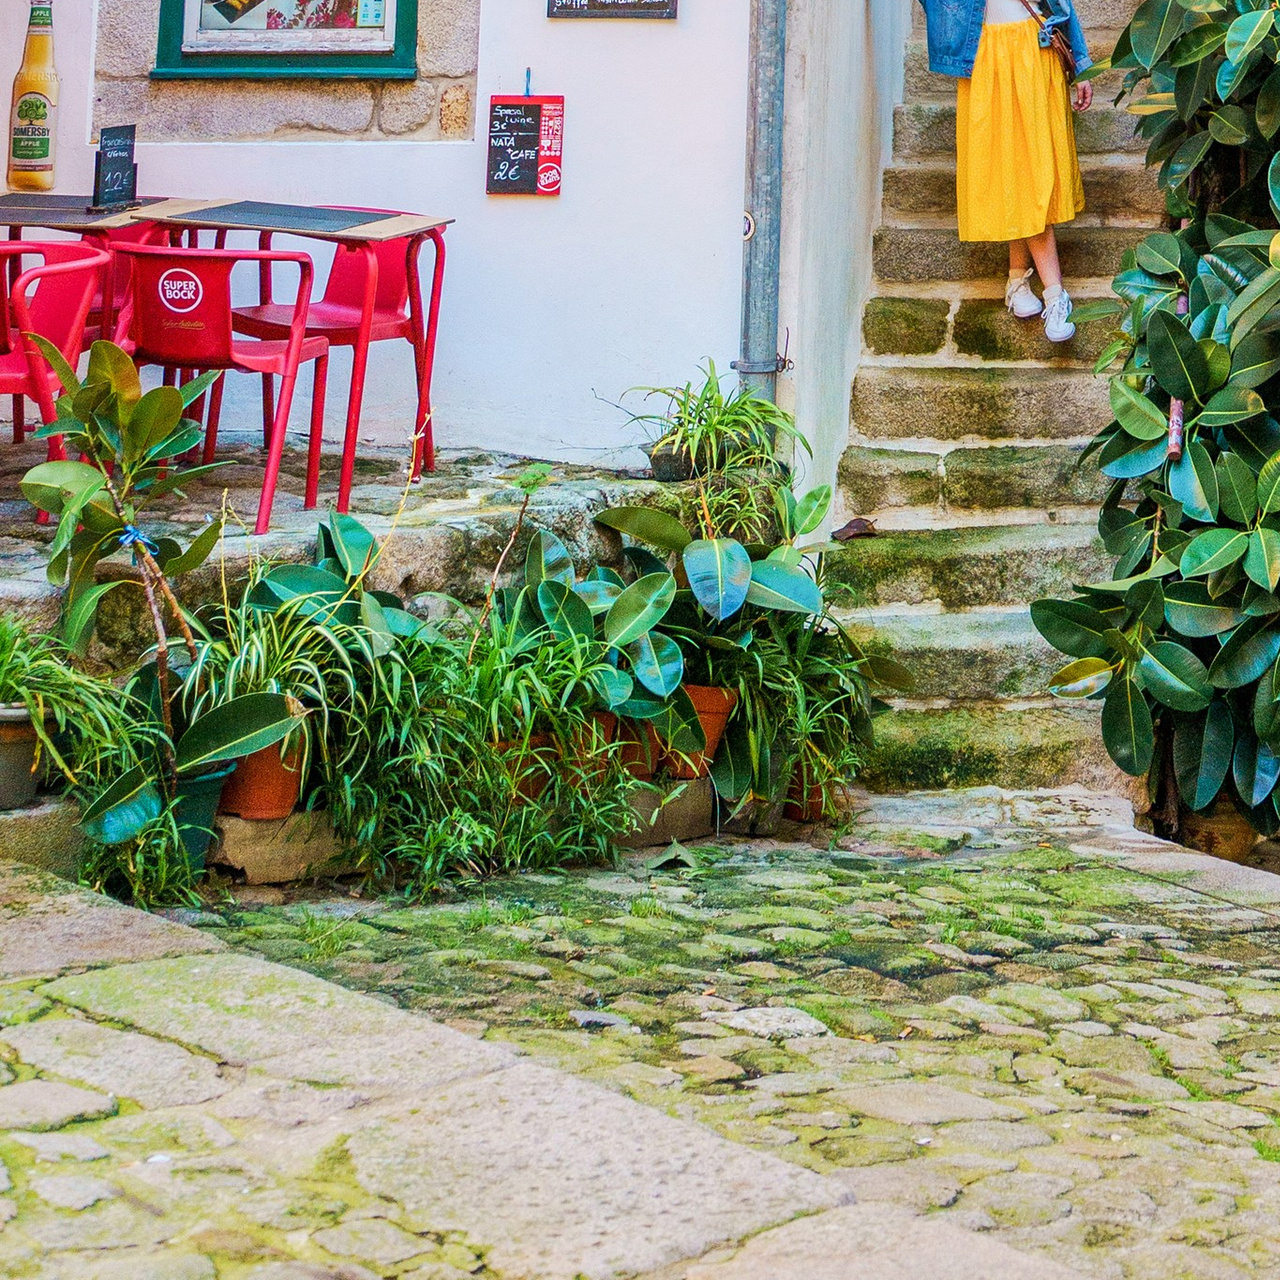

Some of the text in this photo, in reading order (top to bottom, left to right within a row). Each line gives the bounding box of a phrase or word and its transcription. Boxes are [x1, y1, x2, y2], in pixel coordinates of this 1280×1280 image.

[493, 105, 525, 117] Special
[13, 126, 51, 136] SOMERSBY
[491, 136, 515, 147] NATA
[164, 280, 196, 290] SUPER
[166, 290, 196, 299] BOCK
